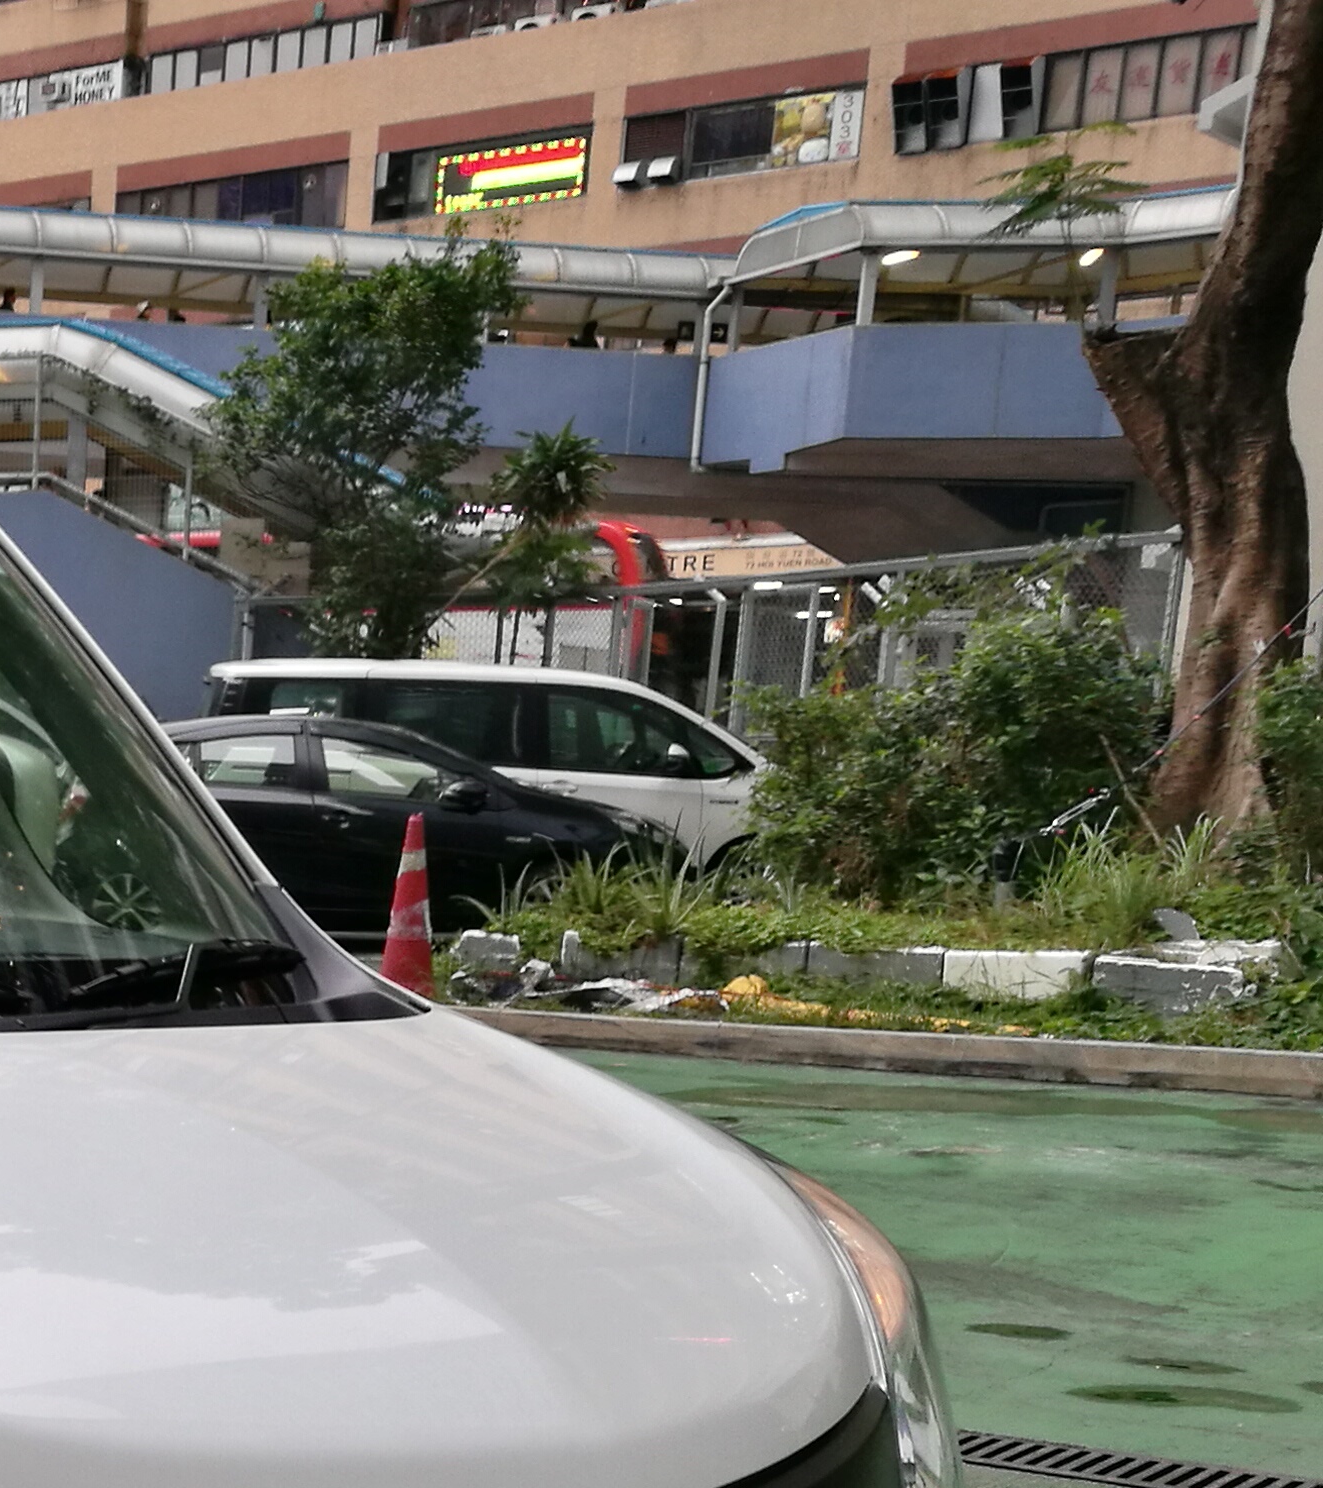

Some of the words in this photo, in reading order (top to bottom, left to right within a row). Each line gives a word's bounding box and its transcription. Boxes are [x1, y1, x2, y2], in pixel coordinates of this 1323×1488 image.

[74, 85, 115, 106] MONEY
[777, 559, 802, 568] YUEN
[804, 557, 832, 567] ROAD
